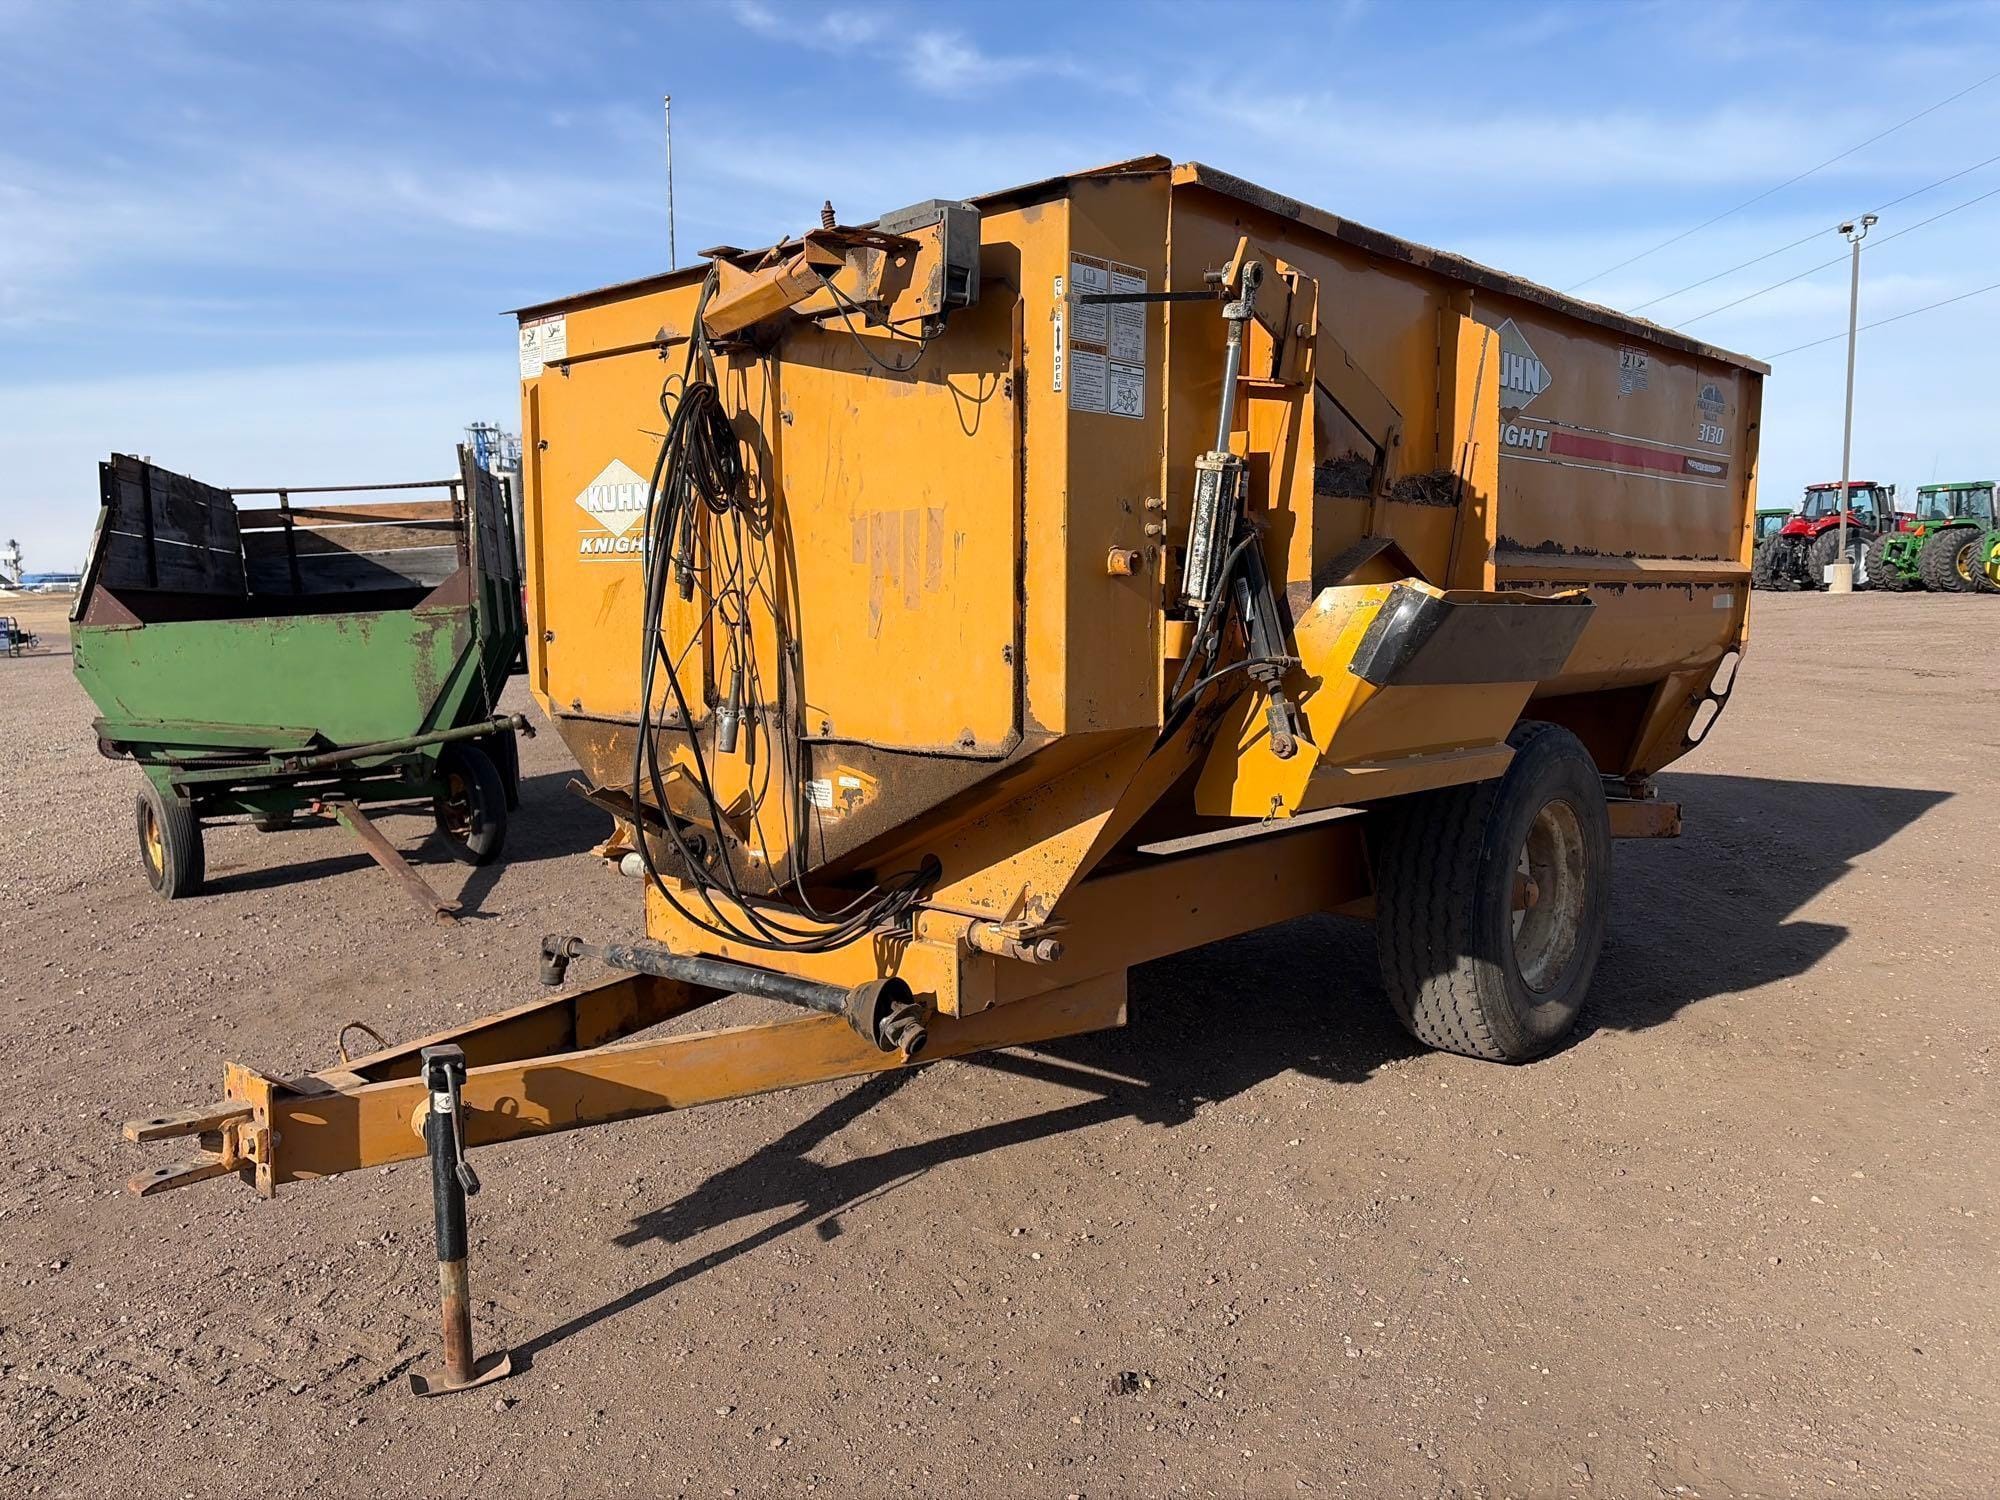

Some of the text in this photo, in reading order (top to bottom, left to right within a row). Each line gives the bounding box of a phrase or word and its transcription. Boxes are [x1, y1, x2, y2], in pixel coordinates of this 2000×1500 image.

[1055, 279, 1063, 321] CLE
[1054, 355, 1062, 388] OPEN
[1500, 351, 1541, 394] UHN
[1499, 423, 1548, 450] IGHT
[1697, 423, 1725, 446] 3130
[587, 482, 651, 513] KUHN
